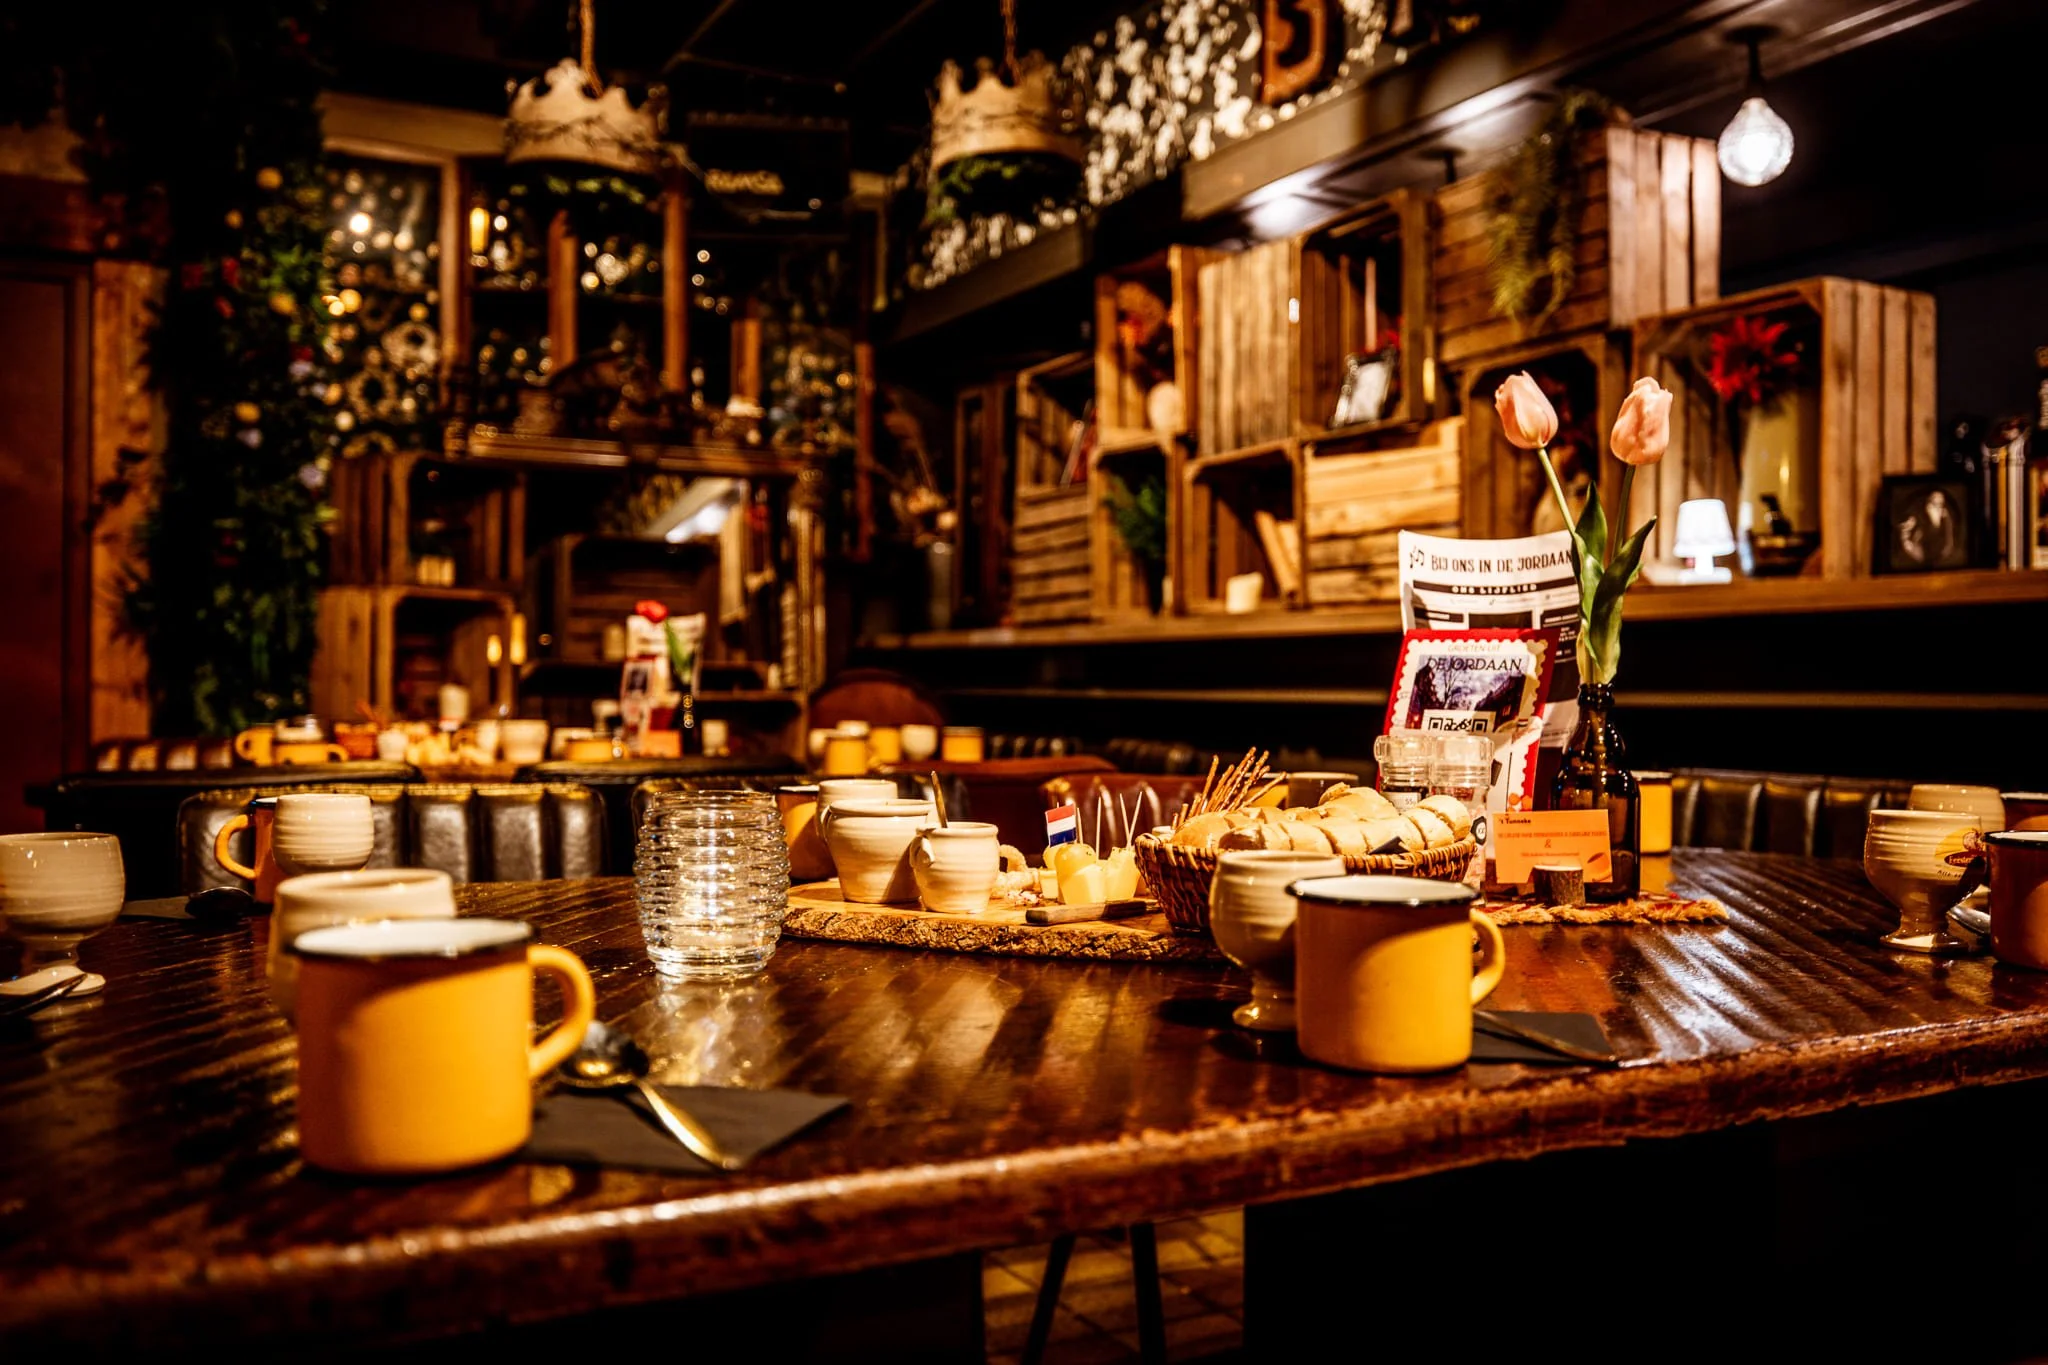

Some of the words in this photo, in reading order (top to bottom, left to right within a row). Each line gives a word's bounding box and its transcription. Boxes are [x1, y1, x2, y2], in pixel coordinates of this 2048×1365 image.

[1431, 554, 1449, 571] BIJ
[1452, 559, 1475, 573] ONS
[1479, 559, 1491, 573] IN
[1497, 559, 1514, 573] DE
[1517, 549, 1572, 571] JORDAAN
[1427, 656, 1445, 671] DE
[1443, 657, 1522, 673] JORDAAN
